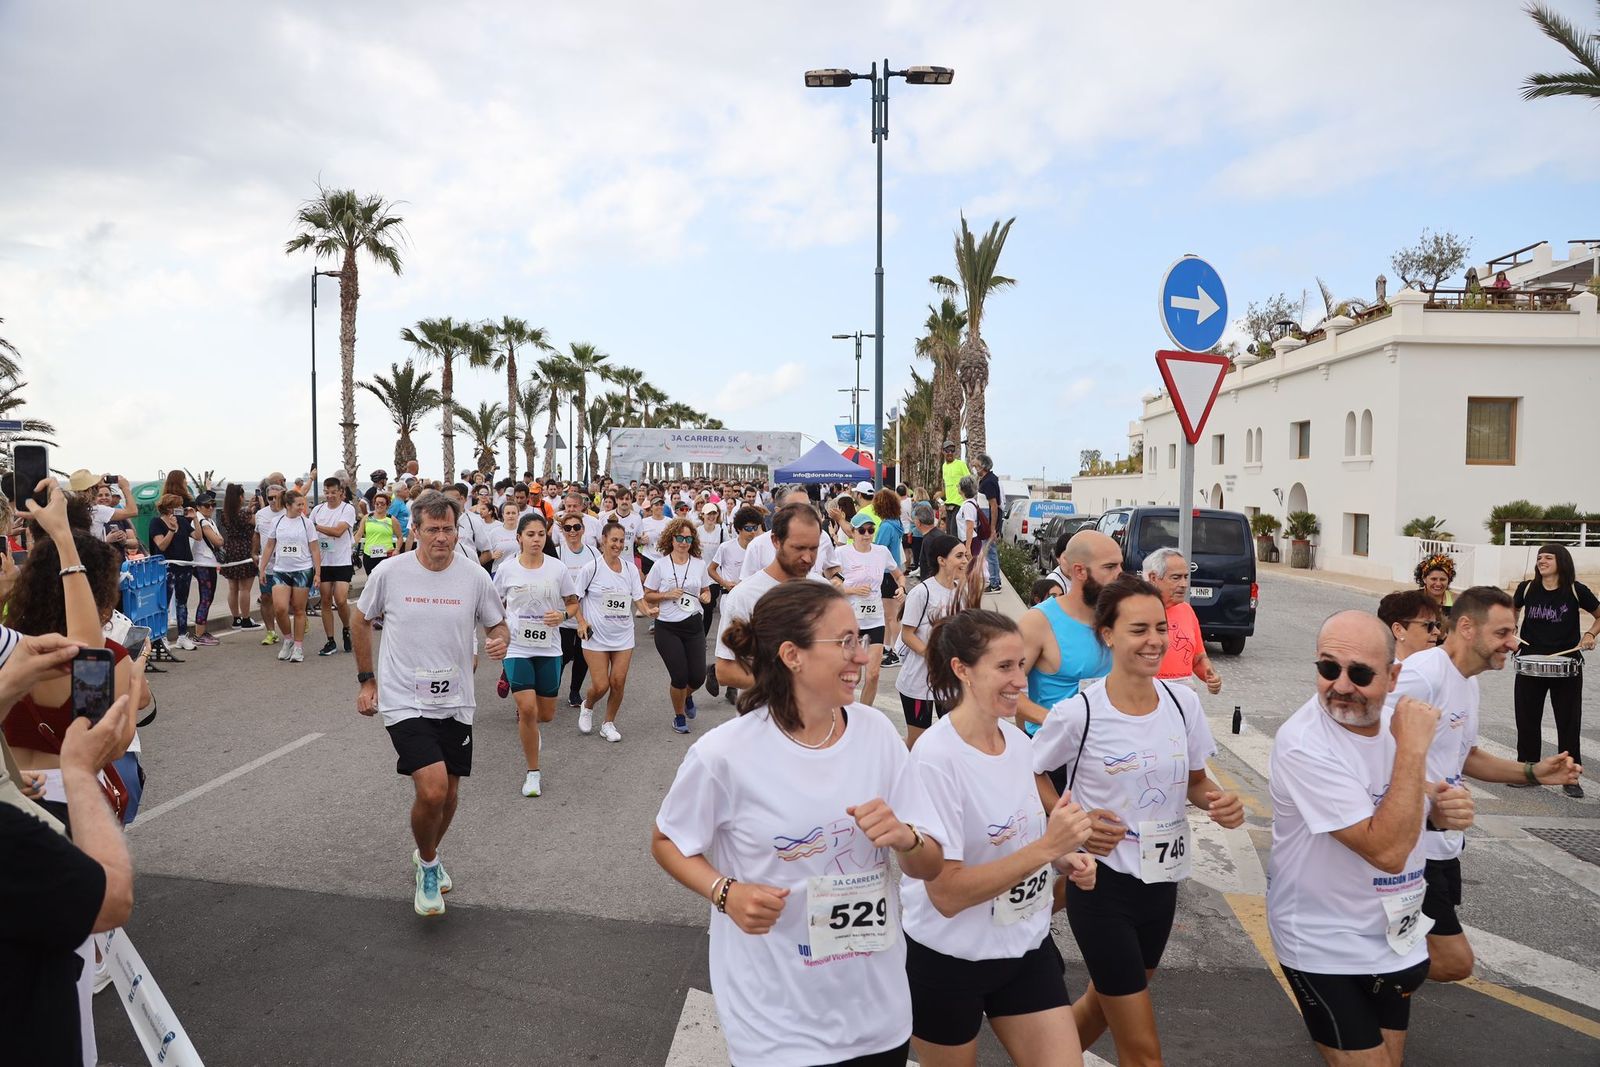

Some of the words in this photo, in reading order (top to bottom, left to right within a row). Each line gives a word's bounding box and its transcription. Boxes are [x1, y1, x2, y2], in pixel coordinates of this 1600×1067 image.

[684, 434, 726, 442] CARRERA
[607, 600, 625, 608] 394
[681, 598, 690, 606] 12
[524, 629, 546, 640] 868
[431, 680, 450, 694] 52
[1155, 836, 1184, 863] 746
[846, 874, 879, 885] CARRERA
[1373, 874, 1406, 886] DONACION
[1009, 870, 1048, 903] 528
[829, 897, 886, 929] 529
